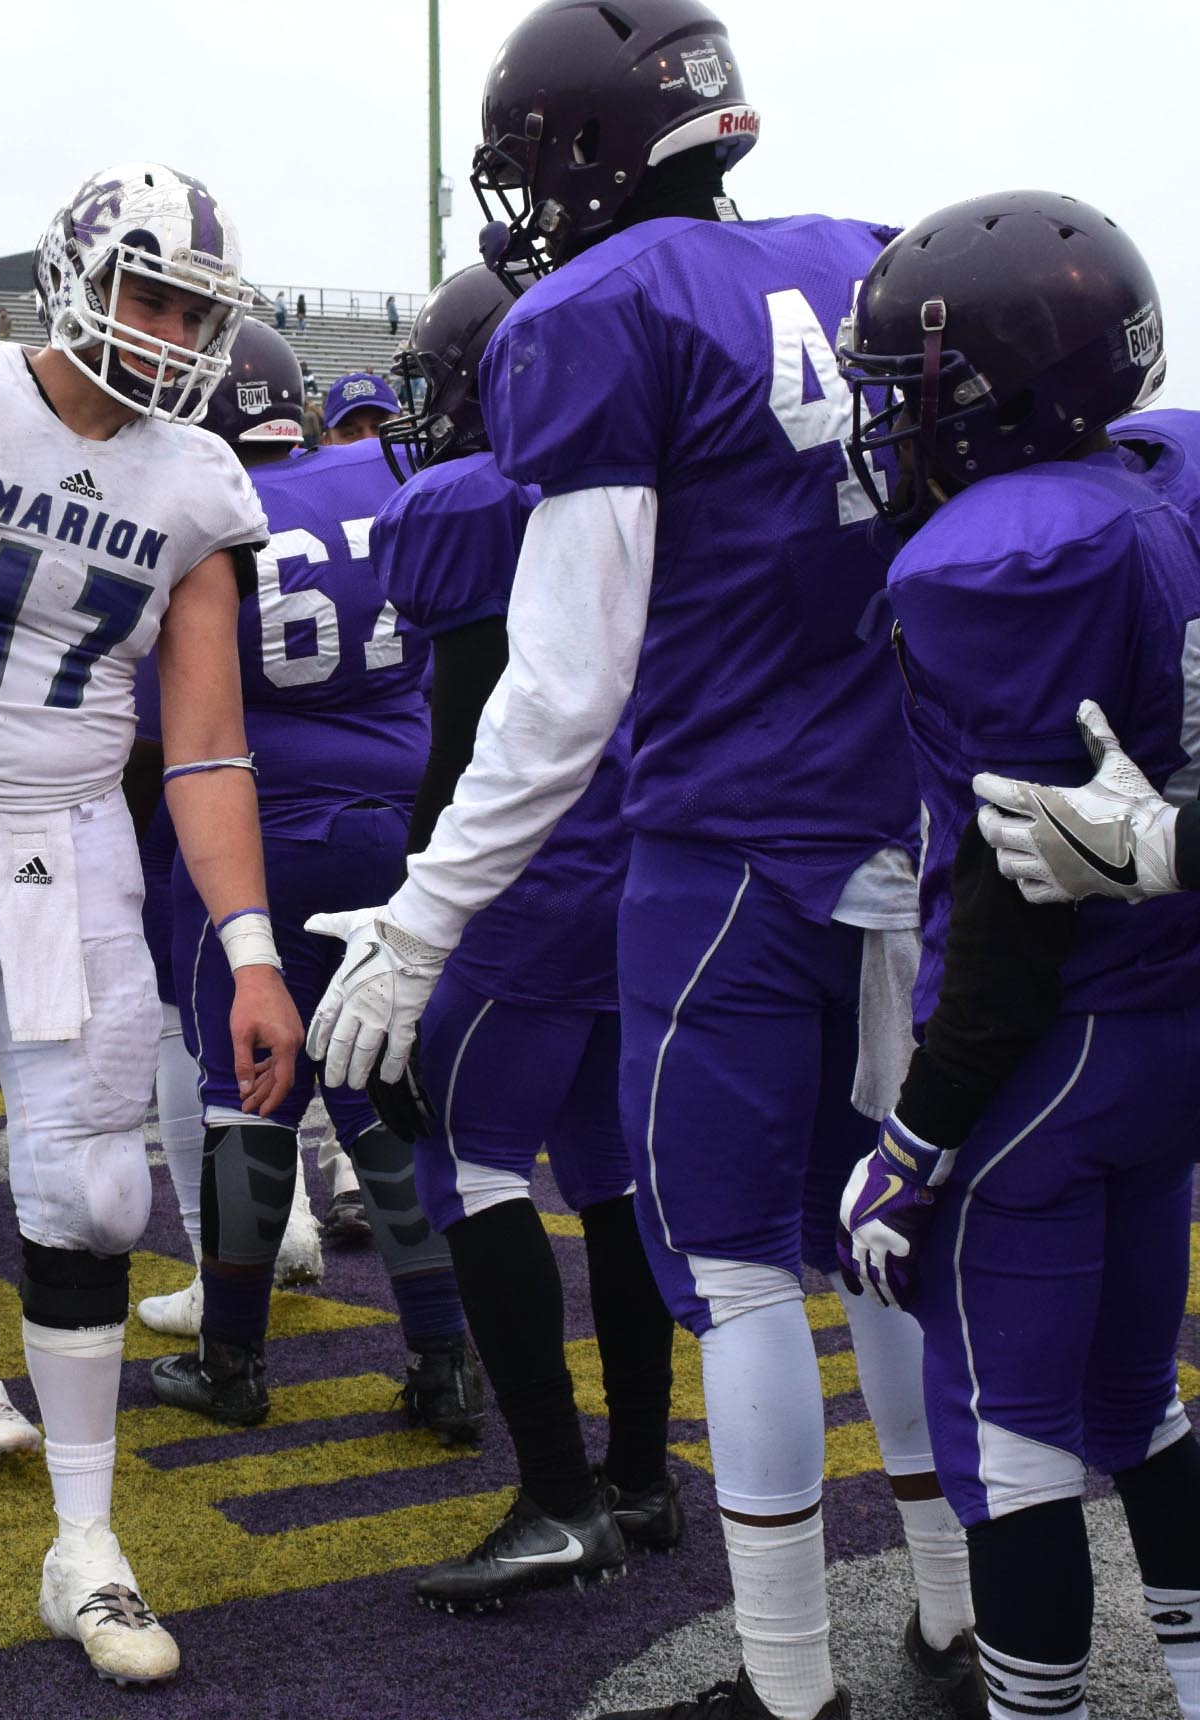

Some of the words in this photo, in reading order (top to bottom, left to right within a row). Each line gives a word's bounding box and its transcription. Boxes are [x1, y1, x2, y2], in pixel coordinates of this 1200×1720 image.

[686, 57, 726, 87] BOWL
[1129, 313, 1160, 359] BOWL
[240, 387, 270, 406] BOWL
[60, 479, 104, 501] adidas
[256, 516, 403, 689] 67
[14, 874, 53, 885] adidas
